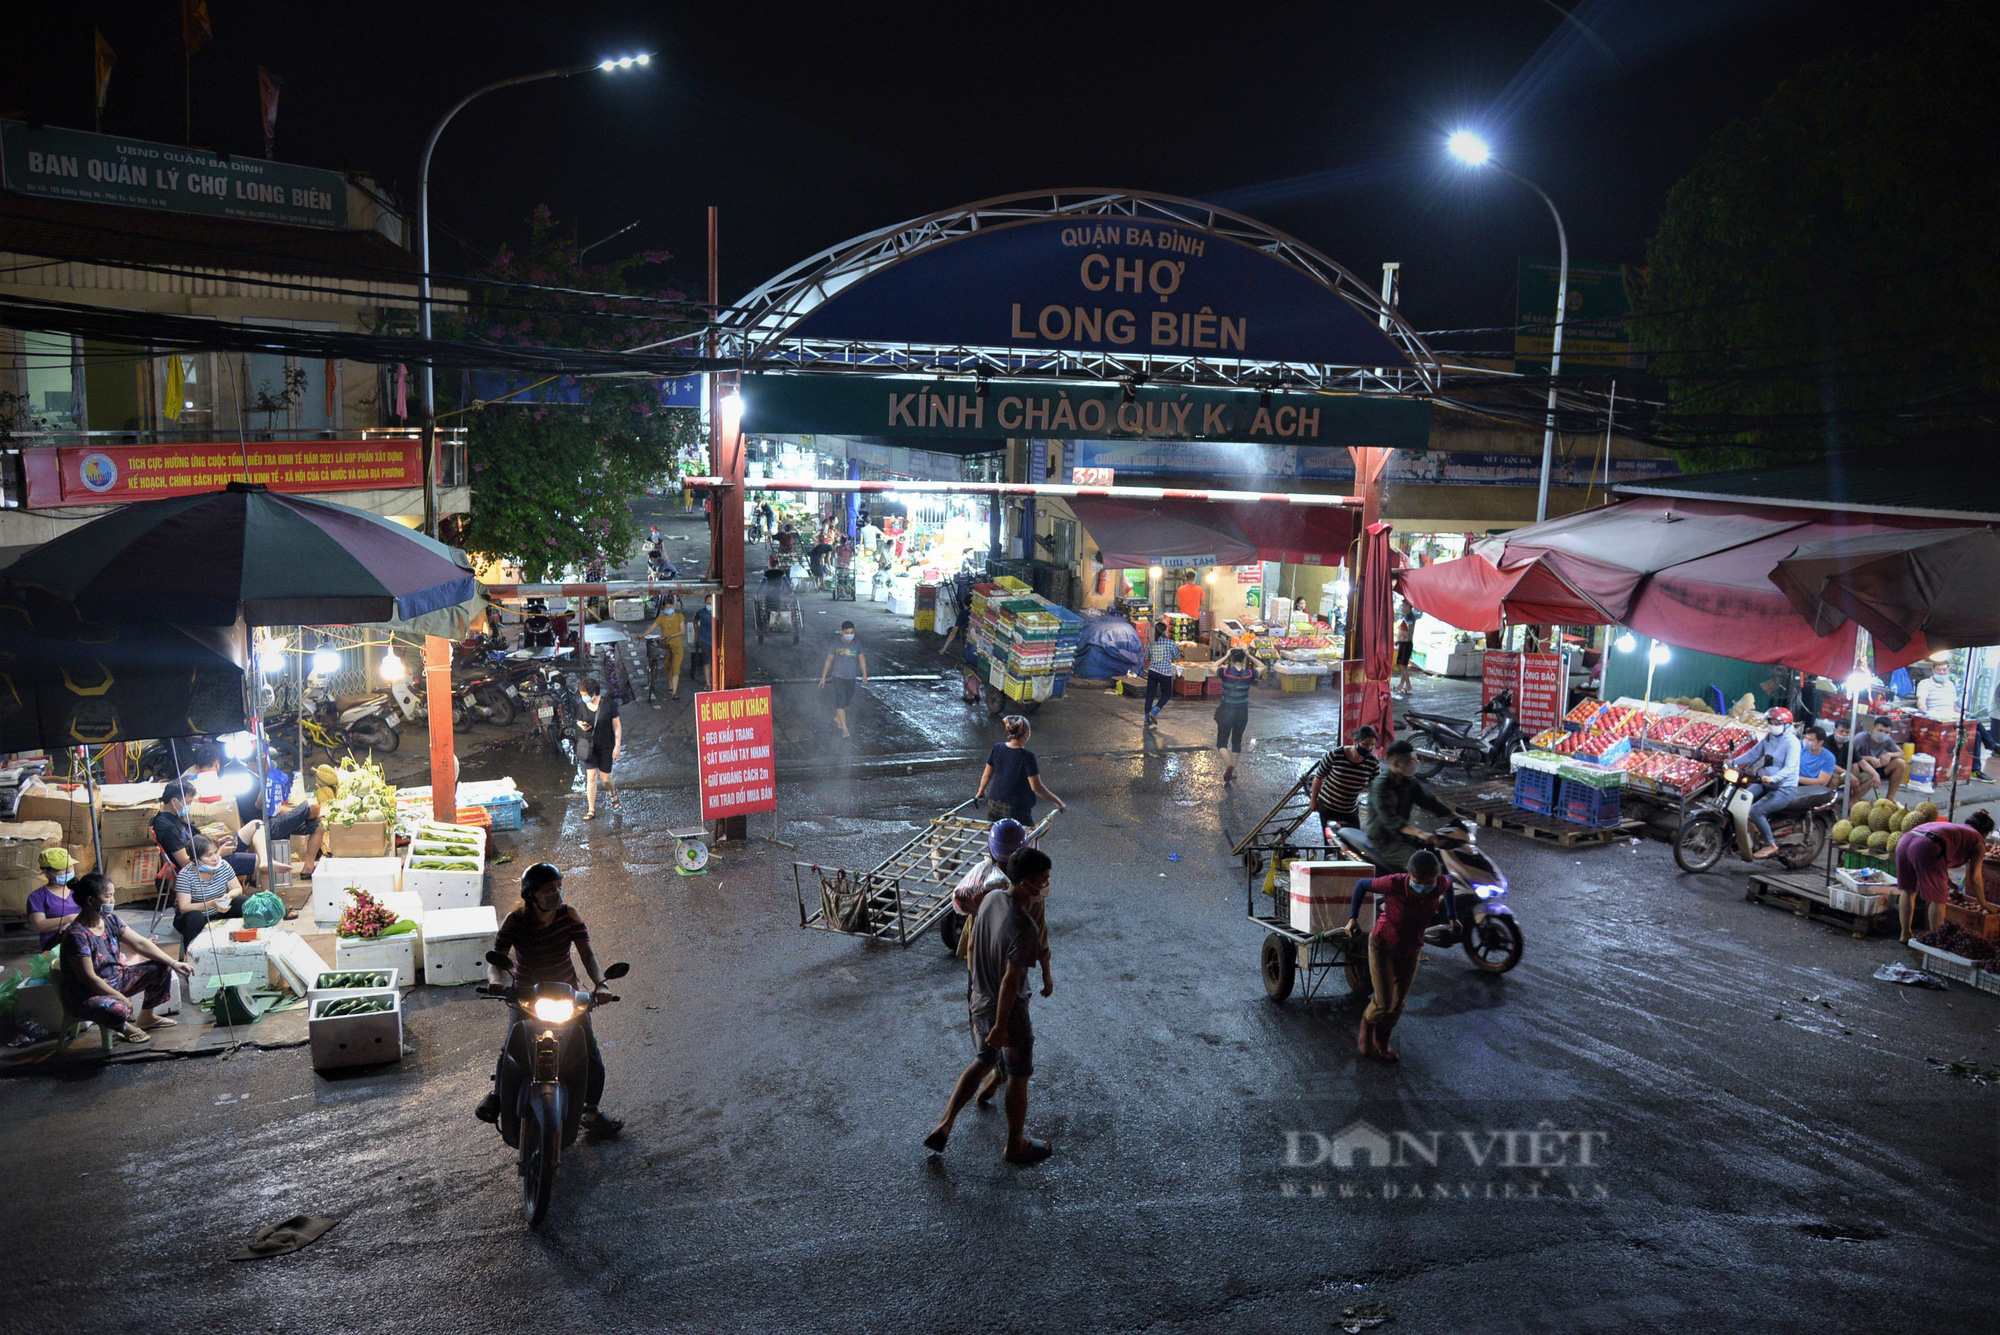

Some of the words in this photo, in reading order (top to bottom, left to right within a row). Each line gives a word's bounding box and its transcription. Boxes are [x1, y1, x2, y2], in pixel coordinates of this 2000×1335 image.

[116, 145, 159, 158] UBND
[163, 153, 206, 166] QUẬN
[210, 160, 227, 170] BA
[231, 162, 263, 174] ĐÌNH
[28, 151, 78, 178] BAN
[87, 157, 148, 186] QUẢN
[156, 167, 180, 190] LÝ
[187, 174, 228, 200] CHỢ
[236, 180, 285, 205] LONG
[291, 187, 332, 210] BIÊN
[1062, 224, 1120, 248] QUẬN
[1126, 228, 1154, 248] BA
[1158, 229, 1206, 258] ĐÌNH
[1080, 253, 1186, 302] CHỢ
[1012, 303, 1136, 344] LONG
[1151, 306, 1247, 350] BIÊN
[888, 386, 984, 428] KÍNH
[998, 390, 1106, 431] CHÀO
[1117, 393, 1194, 434] QUÝ
[128, 456, 146, 470] TÍCH
[147, 458, 162, 471] CỰC
[164, 452, 189, 468] HƯỞNG
[191, 453, 206, 468] ỨNG
[208, 454, 226, 469] CUỘC
[247, 451, 262, 466] ĐIỀU
[264, 454, 277, 465] TRA
[278, 454, 294, 465] KINH
[295, 450, 303, 464] TẾ
[304, 452, 318, 464] NĂM
[320, 453, 334, 463] 2021
[335, 451, 344, 463] LÀ
[344, 451, 356, 463] GÓP
[358, 449, 374, 462] PHẦN
[375, 450, 386, 462] XÂY
[387, 451, 403, 463] DỰNG
[128, 473, 138, 489] KẾ
[140, 476, 168, 490] HOẠCH,
[169, 473, 192, 487] CHÍNH
[193, 473, 212, 485] SÁCH
[214, 472, 230, 484] PHÁT
[254, 472, 269, 483] KINH
[271, 468, 279, 482] TẾ
[285, 469, 294, 482] XÃ
[295, 469, 306, 484] HỘI
[307, 467, 320, 481] CỦA
[321, 466, 330, 480] CẢ
[330, 467, 347, 480] NƯỚC
[348, 467, 356, 479] VÀ
[358, 465, 369, 478] CỦA
[370, 468, 380, 480] ĐỊA
[381, 468, 405, 478] PHƯƠNG
[1541, 670, 1556, 681] BÁO
[701, 697, 710, 722] ĐỀ
[712, 700, 729, 722] NGHỊ
[731, 696, 744, 720] QUÝ
[746, 694, 769, 716] KHÁCH
[706, 732, 718, 745] ĐEO
[719, 725, 734, 744] KHẨU
[735, 727, 754, 741] TRANG
[706, 749, 718, 765] SÁT
[719, 745, 738, 763] KHUẨN
[739, 747, 749, 760] TAY
[750, 745, 770, 759] NHANH
[708, 771, 718, 788] GIỮ
[720, 766, 742, 786] KHOẢNG
[743, 766, 758, 782] CÁCH
[760, 768, 769, 779] 2m
[709, 795, 719, 808] KHI
[720, 792, 735, 807] TRAO
[736, 786, 746, 804] ĐỔI
[747, 789, 760, 803] MUA
[761, 787, 773, 800] BÁN
